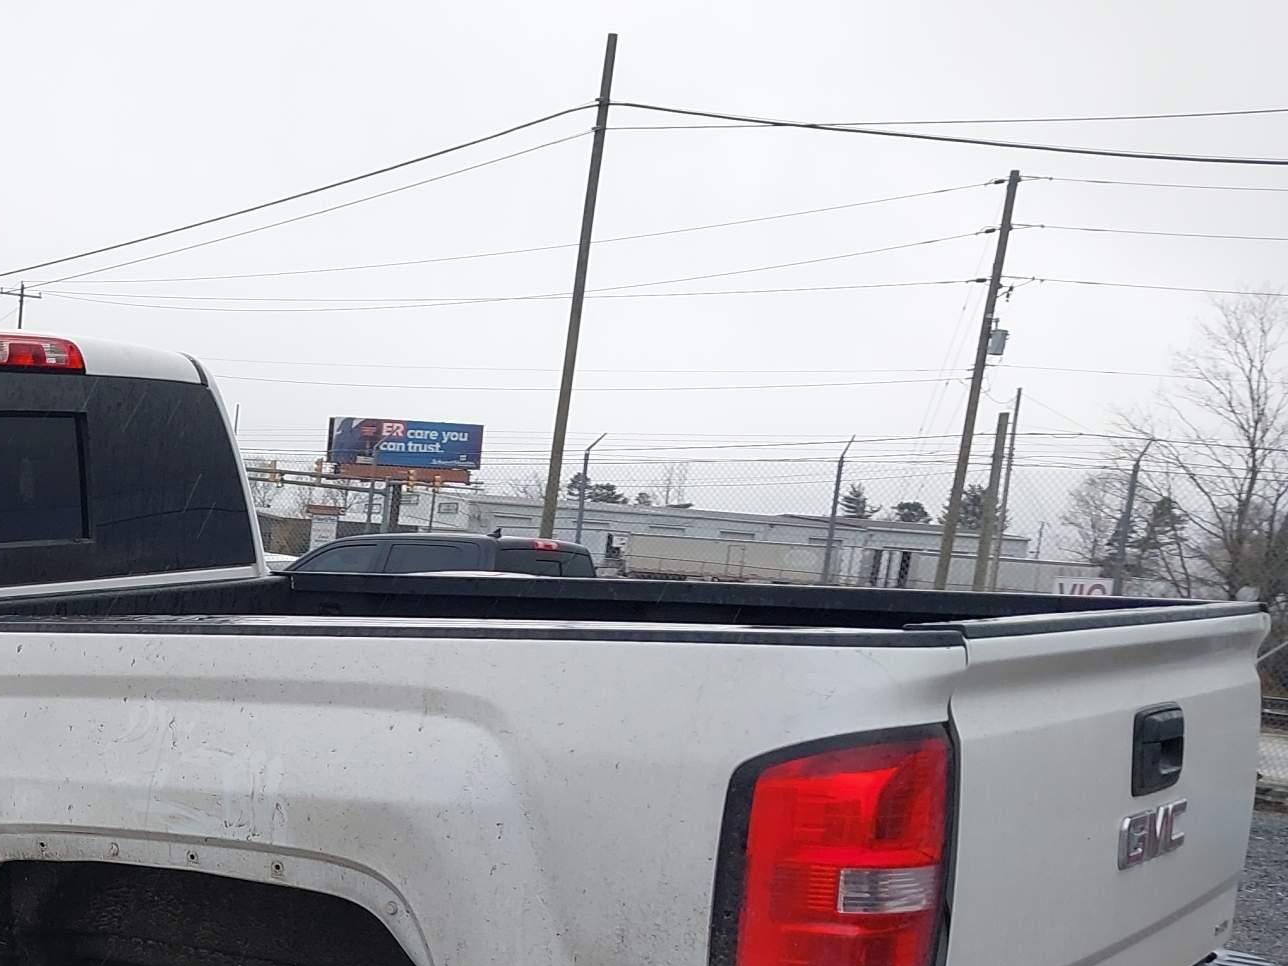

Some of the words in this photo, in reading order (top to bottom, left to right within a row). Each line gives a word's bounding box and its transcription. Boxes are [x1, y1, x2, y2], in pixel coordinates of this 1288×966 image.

[381, 422, 404, 437] ER
[407, 428, 438, 440] care
[442, 431, 469, 444] you
[379, 441, 405, 451] can
[407, 441, 444, 453] trust.
[1117, 798, 1188, 871] GMC
